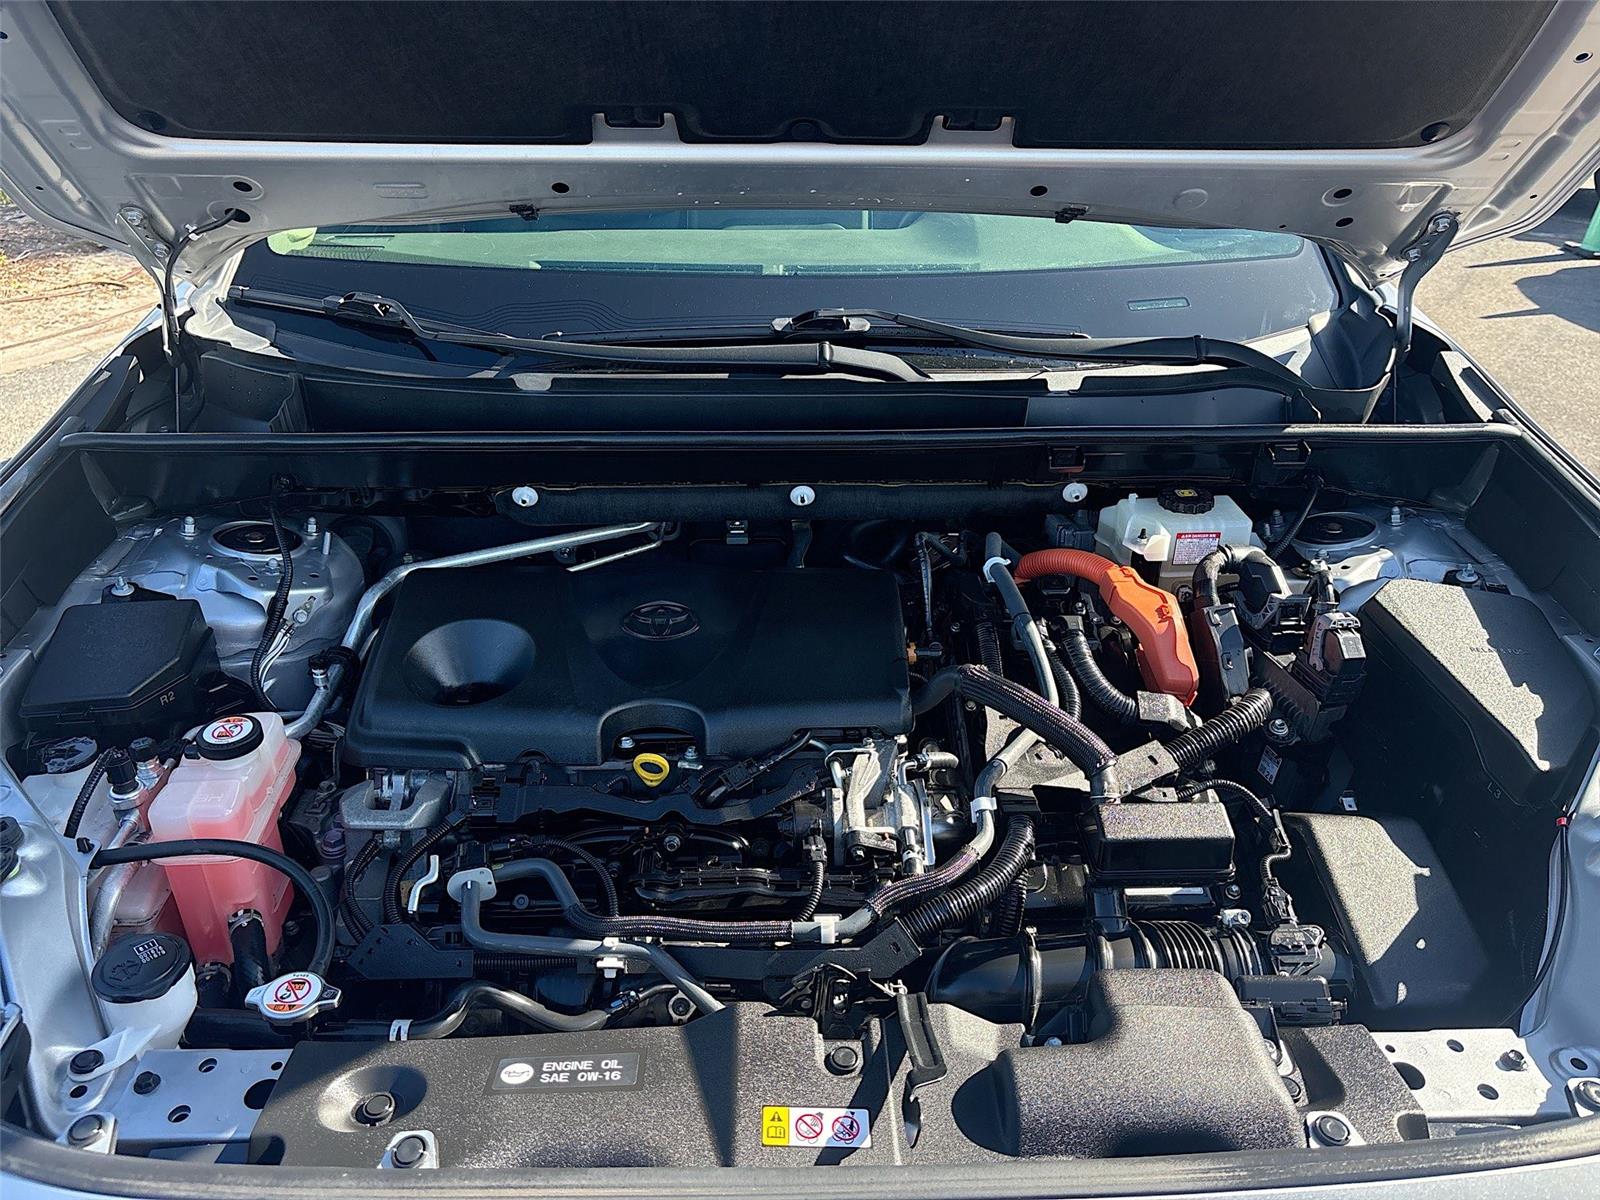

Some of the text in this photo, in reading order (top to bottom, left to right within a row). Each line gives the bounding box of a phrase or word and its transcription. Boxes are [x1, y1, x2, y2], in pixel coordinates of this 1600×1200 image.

[160, 691, 176, 705] R2
[542, 1059, 624, 1072] ENGINE OIL
[540, 1070, 622, 1083] SAE 0W-16
